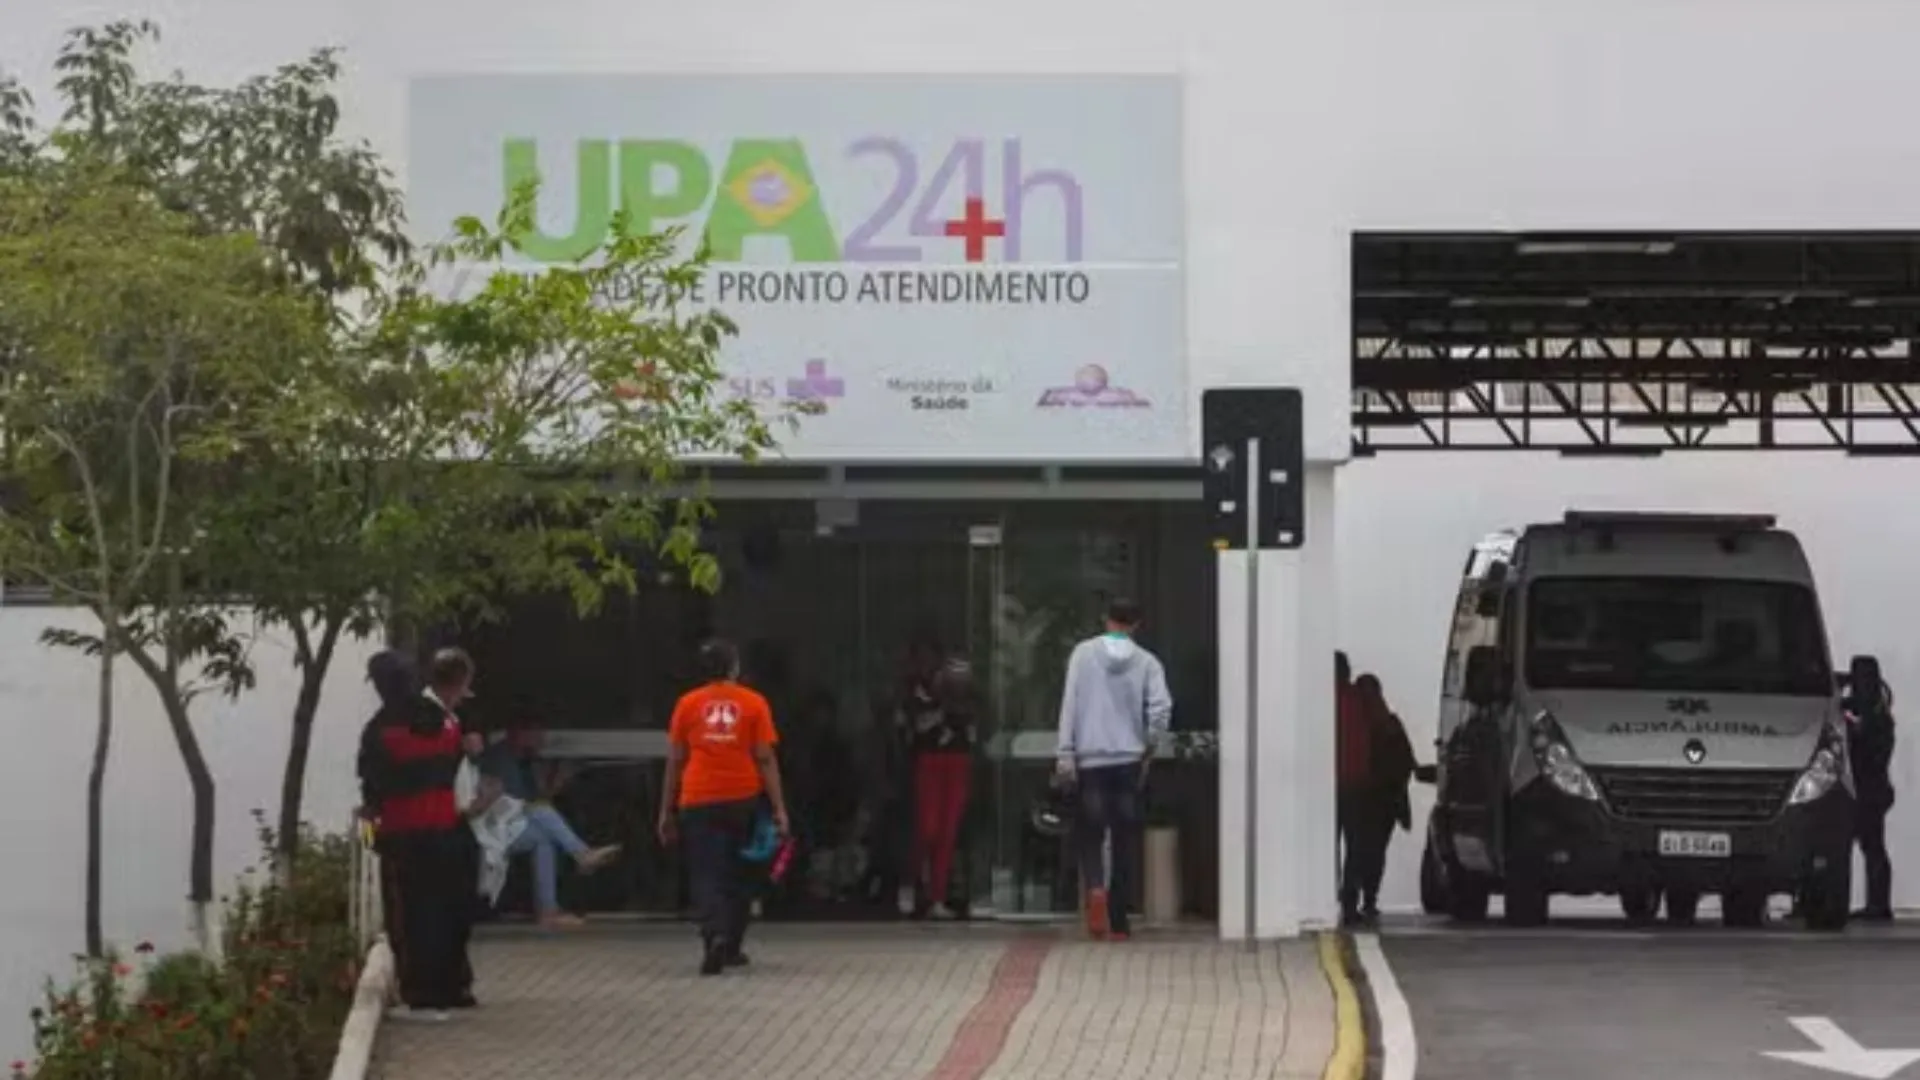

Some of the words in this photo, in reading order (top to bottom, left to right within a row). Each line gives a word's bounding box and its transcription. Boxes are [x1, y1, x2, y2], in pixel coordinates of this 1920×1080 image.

[503, 138, 836, 261] UPA
[843, 138, 1083, 262] 24h
[718, 271, 847, 302] PRONTO
[857, 271, 1090, 303] ATENDIMENTO
[728, 379, 777, 398] SUS
[910, 394, 969, 410] Saúde
